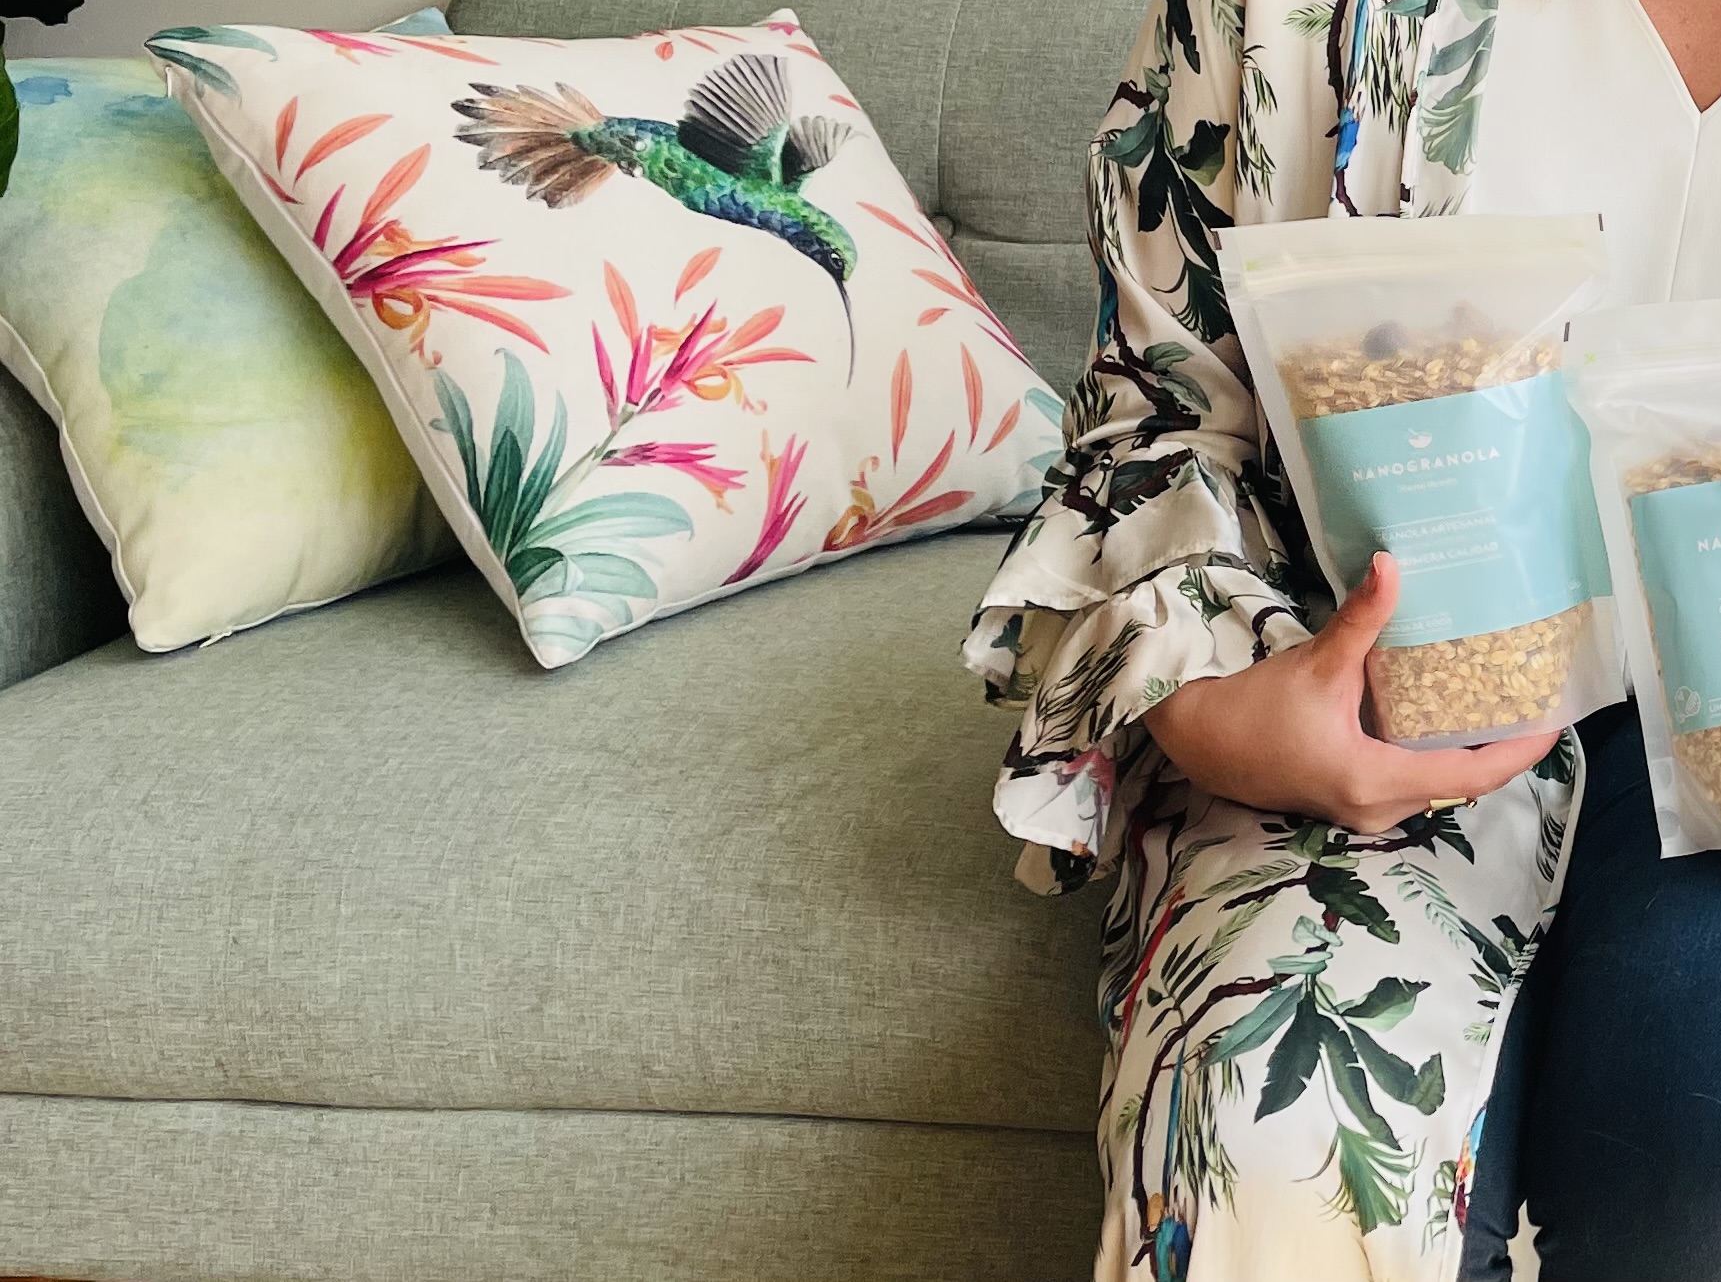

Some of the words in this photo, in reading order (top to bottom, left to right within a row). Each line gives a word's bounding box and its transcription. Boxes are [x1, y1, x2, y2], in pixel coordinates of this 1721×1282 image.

[1352, 446, 1500, 482] NANOGRANOLA
[1379, 526, 1428, 542] RANOLA
[1449, 541, 1499, 560] CALIDAD
